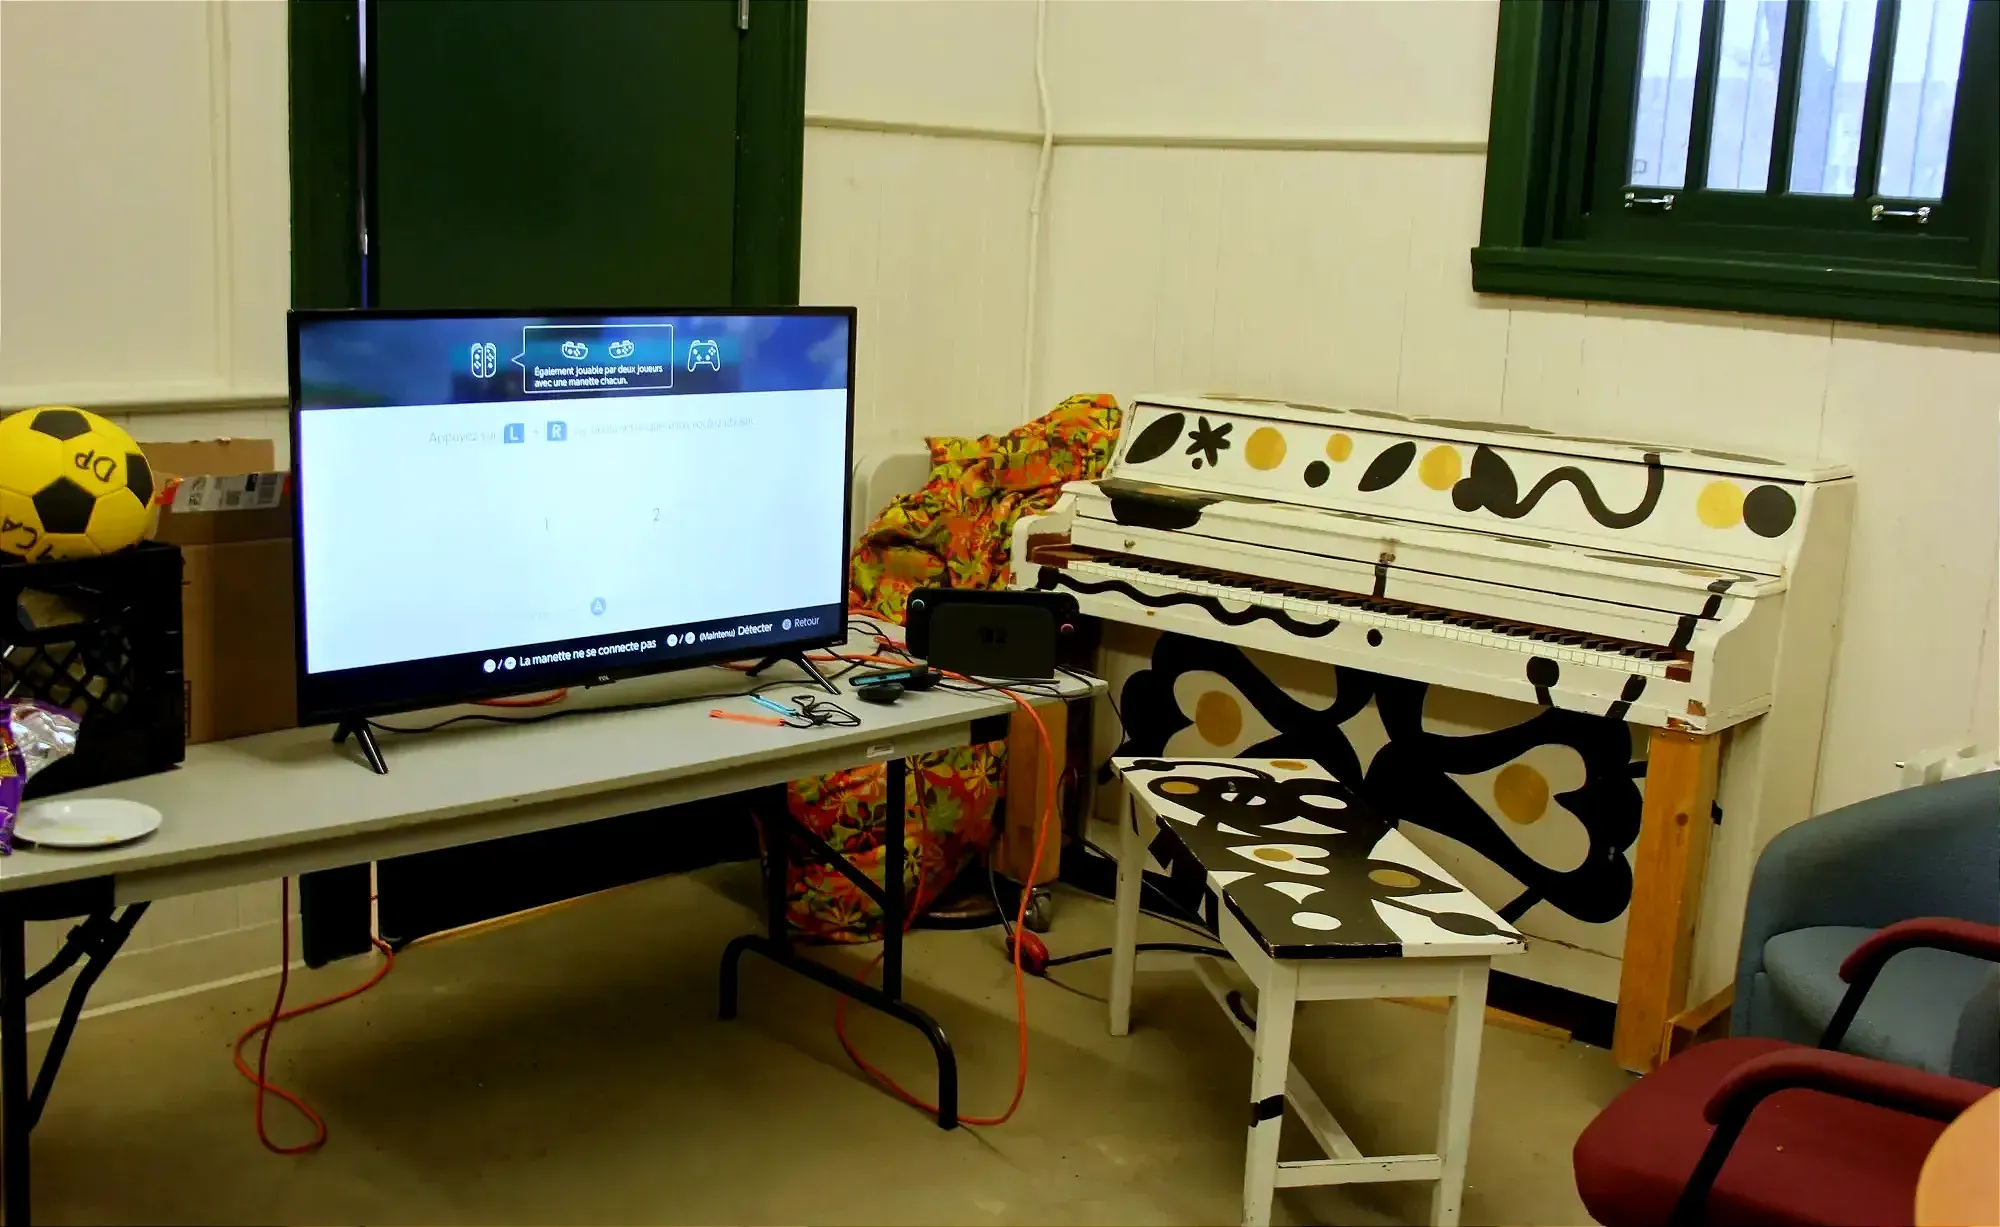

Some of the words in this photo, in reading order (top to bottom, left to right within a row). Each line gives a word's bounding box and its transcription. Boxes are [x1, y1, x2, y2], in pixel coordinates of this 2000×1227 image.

[534, 365, 575, 379] Également
[575, 364, 604, 377] jouable
[604, 366, 617, 378] par
[617, 364, 636, 374] deux
[636, 364, 664, 376] joueurs
[534, 378, 553, 388] avec
[553, 378, 568, 387] une
[568, 377, 600, 387] manette
[600, 376, 629, 386] chacun.
[652, 507, 660, 522] 2
[794, 616, 820, 628] Retour
[699, 628, 736, 642] (Maintenu)
[737, 622, 773, 637] Détecter
[519, 656, 532, 667] La
[532, 651, 572, 665] manette
[573, 649, 585, 659] ne
[585, 647, 597, 658] se
[597, 642, 639, 656] connecte
[640, 638, 657, 652] pas
